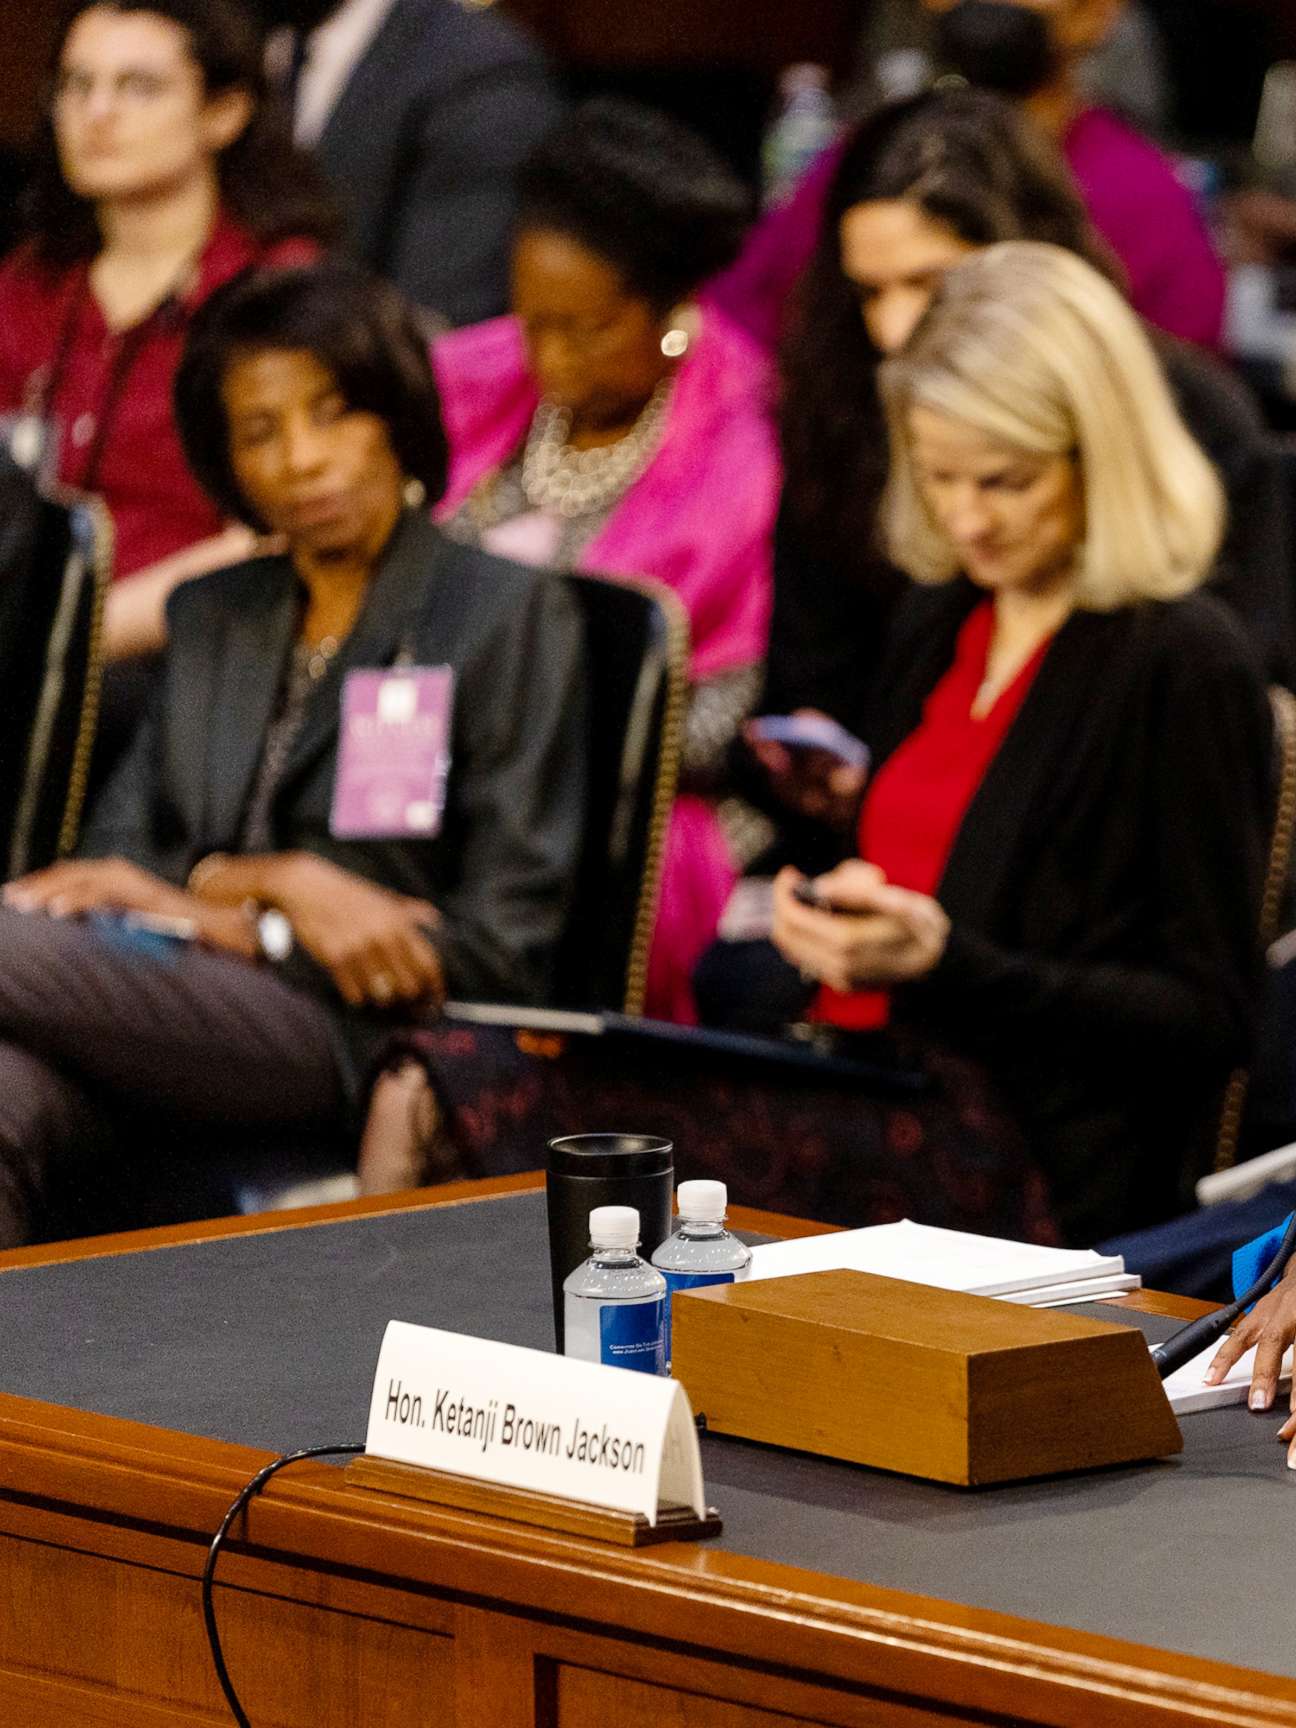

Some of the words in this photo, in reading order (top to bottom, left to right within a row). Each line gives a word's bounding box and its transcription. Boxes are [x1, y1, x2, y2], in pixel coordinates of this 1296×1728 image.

[385, 1379, 425, 1428] Hon.
[432, 1389, 498, 1452] Ketanji
[501, 1404, 561, 1456] Brown
[566, 1418, 645, 1474] Jackson
